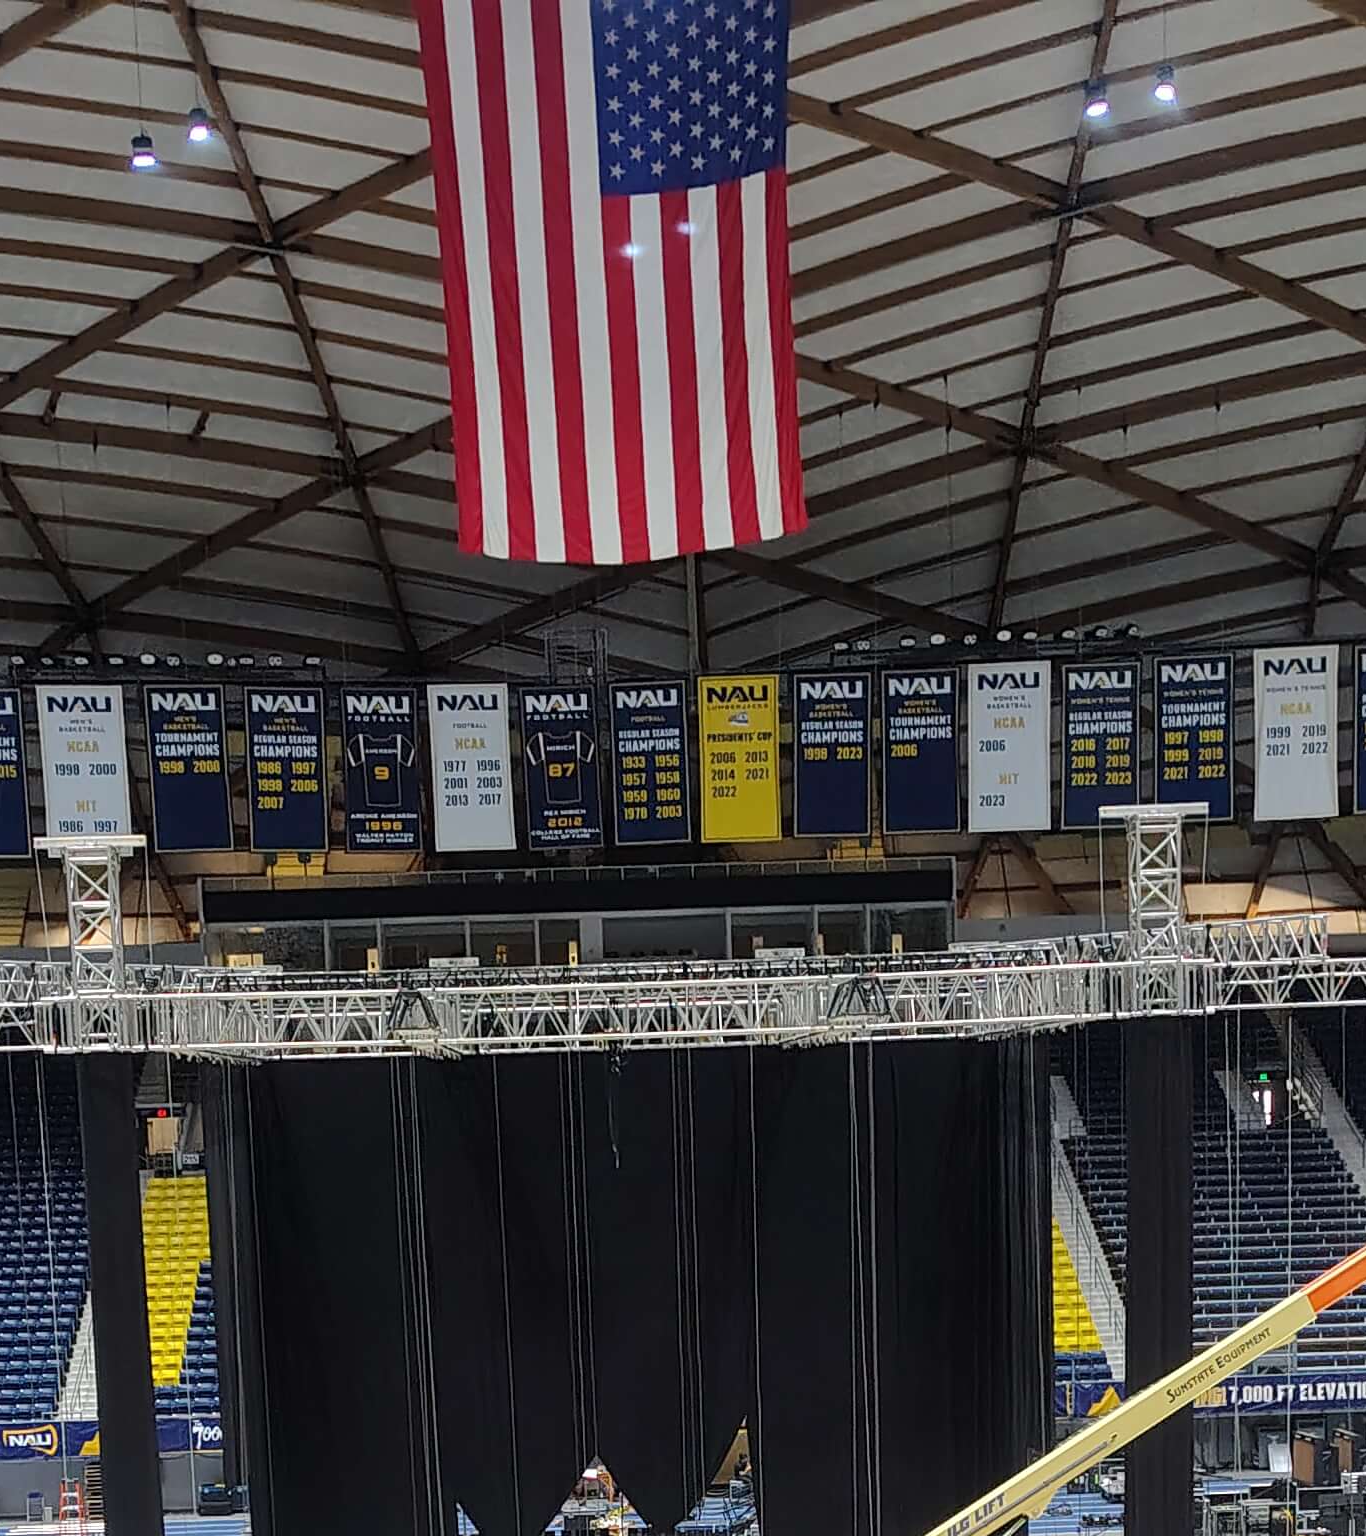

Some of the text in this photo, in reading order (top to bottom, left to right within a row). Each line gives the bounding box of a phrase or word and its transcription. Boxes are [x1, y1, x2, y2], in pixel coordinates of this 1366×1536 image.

[1162, 662, 1225, 682] NAU
[1264, 657, 1326, 676] NAU
[889, 677, 951, 696] NAU
[978, 672, 1039, 690] NAU
[1068, 671, 1131, 690] NAU
[707, 685, 767, 703] NAU
[800, 681, 863, 699] NAU
[47, 696, 112, 713] NAU
[150, 692, 216, 711] NAU
[251, 695, 315, 712] NAU
[346, 696, 409, 714] NAU
[438, 696, 498, 712] NAU
[525, 694, 587, 712] NAU
[616, 689, 677, 708] NAU
[1162, 702, 1225, 714] TOURNAMENT
[527, 712, 588, 720] FOOTBALL
[890, 716, 951, 726] TOURNAMENT
[1069, 711, 1132, 720] REGULAR SEASON
[1162, 714, 1225, 728] CHAMPIONS
[836, 721, 863, 729] SEASON
[1069, 722, 1132, 735] CHAMPIONS
[1302, 725, 1326, 737] 2019
[155, 733, 219, 743] TOURNAMENT
[652, 728, 679, 737] SEASON
[757, 732, 772, 740] CUP
[801, 731, 863, 744] CHAMPIONS
[890, 726, 952, 740] CHAMPIONS
[1165, 732, 1188, 744] 1997
[254, 735, 317, 744] REGULAR SEASON
[619, 738, 680, 753] CHAMPIONS
[979, 740, 1005, 752] 2006
[1106, 738, 1130, 750] 2017
[155, 744, 220, 757] CHAMPIONS
[254, 746, 317, 758] CHAMPIONS
[837, 747, 863, 759] 2023
[891, 745, 917, 757] 2006
[1267, 742, 1328, 756] 2021 2022
[711, 751, 768, 764] 2006 2013
[1106, 755, 1130, 767] 2019
[55, 764, 117, 775] 1998 2000
[193, 760, 220, 773] 2000
[257, 762, 315, 774] 1986 1997
[374, 766, 389, 779] 9
[444, 760, 501, 772] 1977 1996
[549, 762, 575, 777] 87
[1164, 765, 1225, 780] 2021 2022
[622, 772, 646, 785] 1957
[712, 768, 769, 781] 2014 2021
[1071, 773, 1131, 786] 2022 2023
[444, 777, 502, 789] 2001 2003
[712, 786, 736, 798] 2022
[258, 797, 284, 808] 2007
[445, 794, 501, 806] 2013 2017
[979, 795, 1005, 806] 2023
[656, 806, 683, 818] 2003
[93, 820, 117, 833] 1997
[1215, 1327, 1271, 1369] EQUIPMENT
[1228, 1385, 1274, 1405] 7,000
[1277, 1384, 1296, 1402] FT
[9, 1434, 51, 1447] NAU
[976, 1492, 1004, 1521] LIFT
